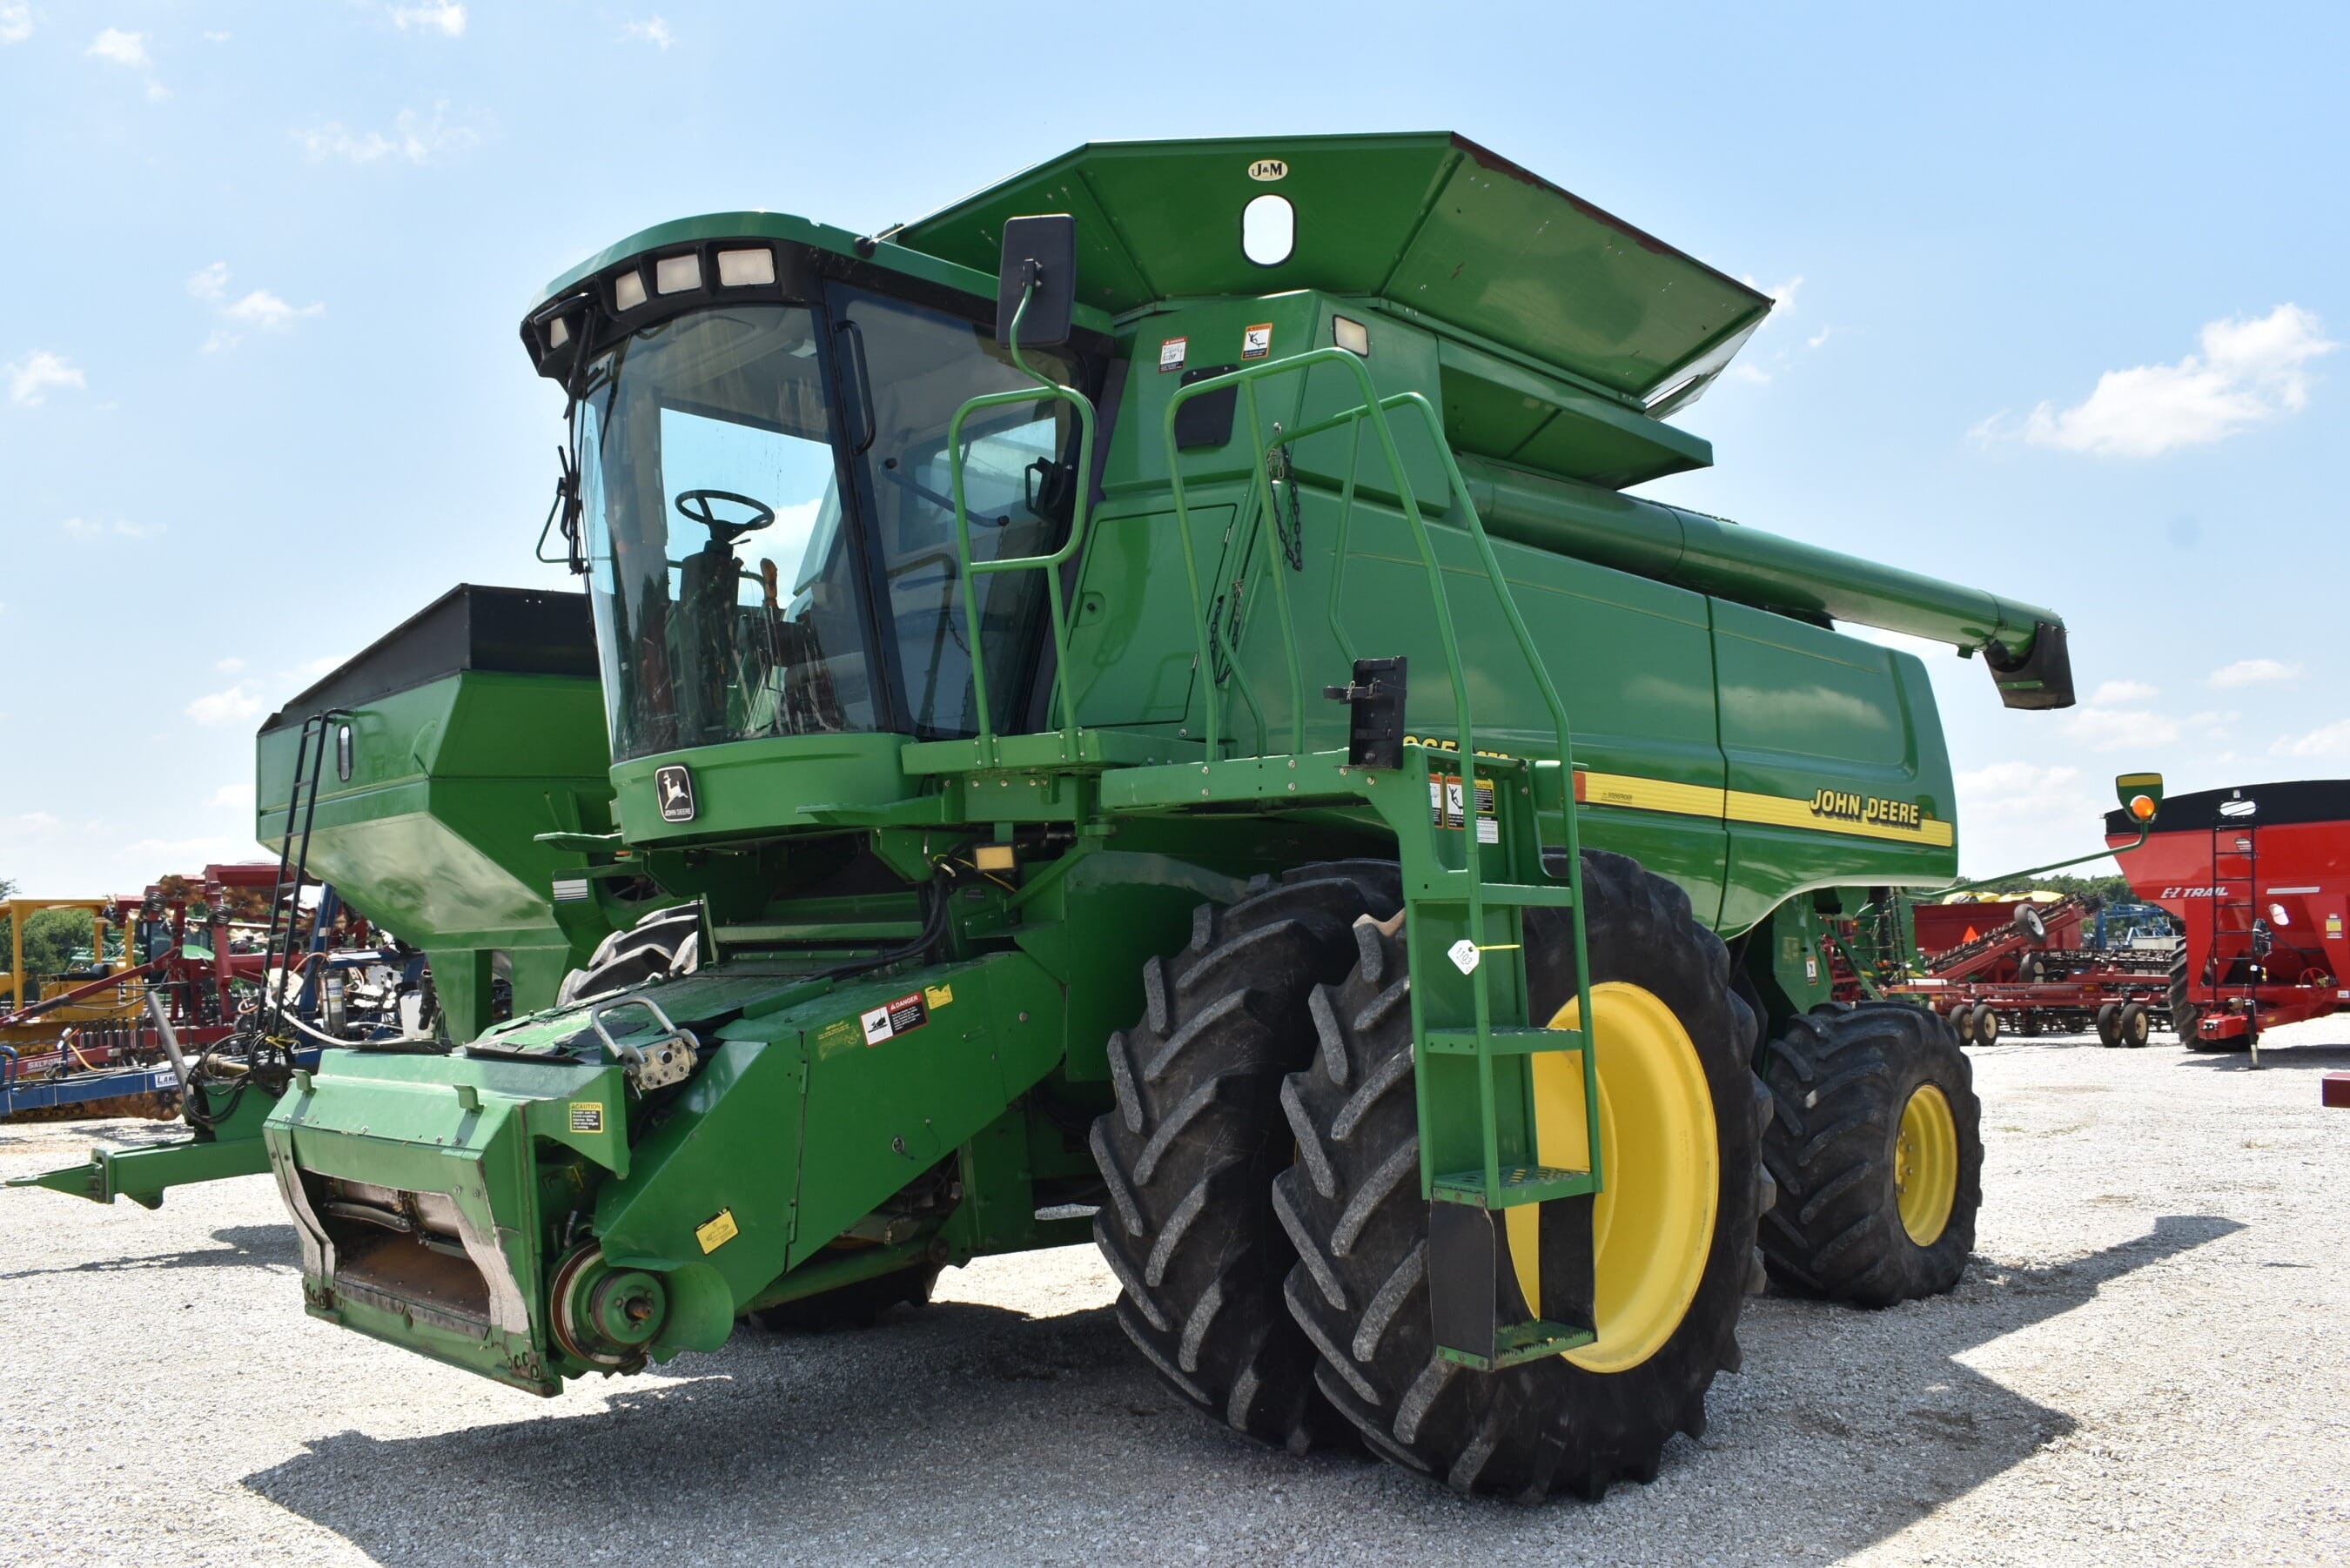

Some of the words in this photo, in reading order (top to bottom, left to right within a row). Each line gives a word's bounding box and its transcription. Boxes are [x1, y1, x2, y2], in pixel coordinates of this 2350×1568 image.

[1252, 163, 1283, 177] J&M
[1810, 788, 1862, 818] JOHN
[1866, 796, 1920, 827] DEERE
[2182, 886, 2229, 898] TRAIL
[895, 995, 918, 1008] DANGER
